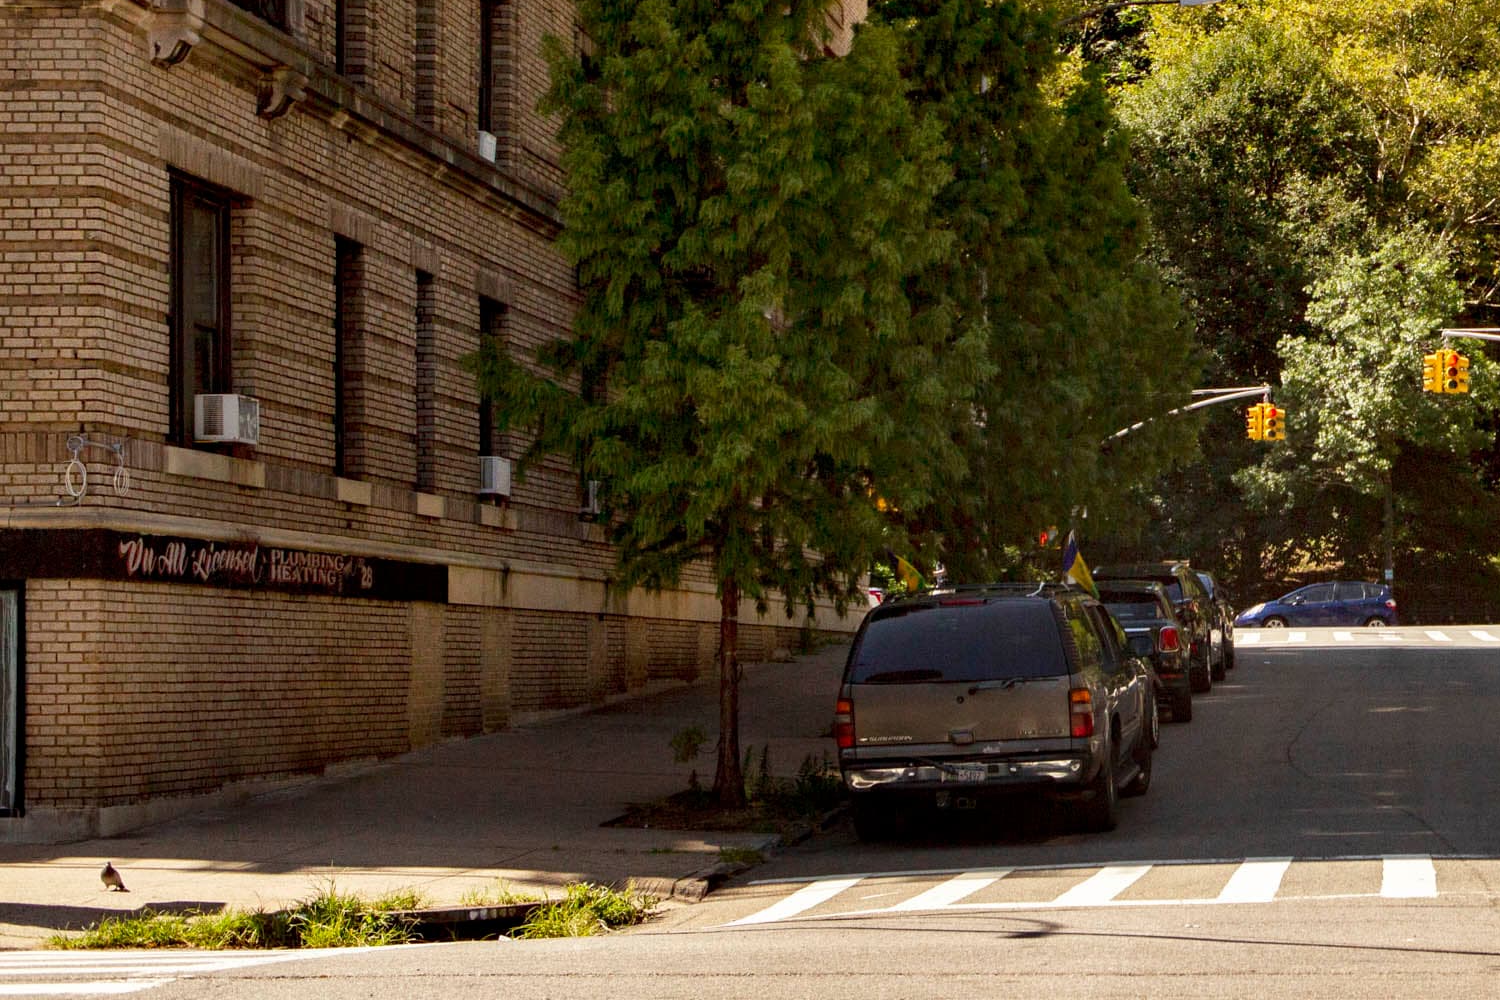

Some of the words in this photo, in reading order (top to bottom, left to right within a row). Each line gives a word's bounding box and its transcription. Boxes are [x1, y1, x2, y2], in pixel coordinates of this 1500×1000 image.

[158, 542, 188, 576] All
[192, 541, 263, 582] Licensed
[270, 549, 344, 571] PLUMBING
[270, 565, 336, 585] HEATING
